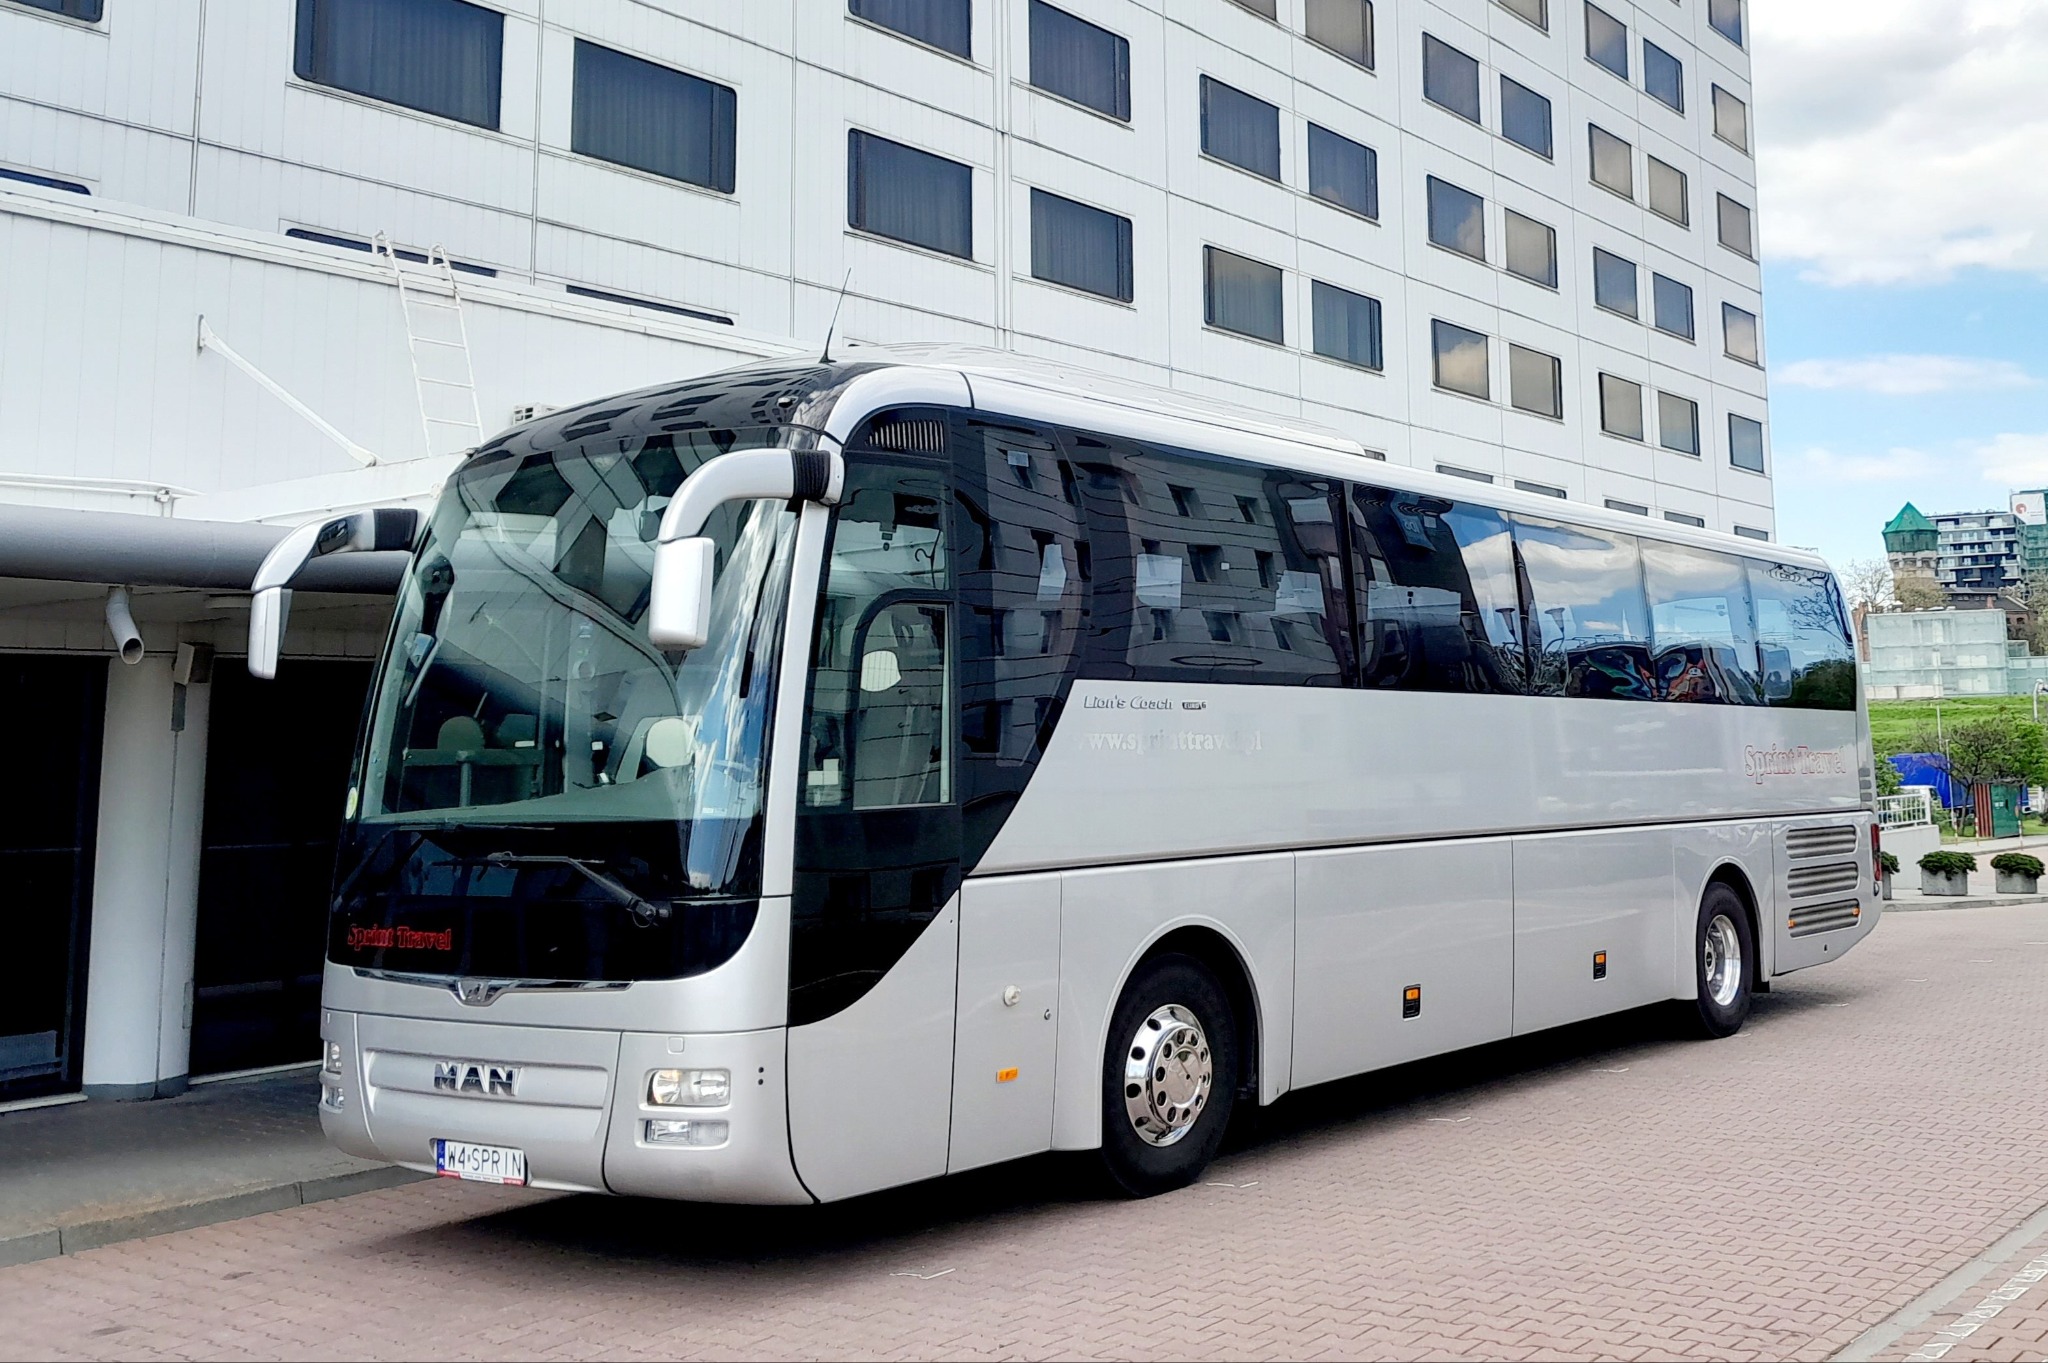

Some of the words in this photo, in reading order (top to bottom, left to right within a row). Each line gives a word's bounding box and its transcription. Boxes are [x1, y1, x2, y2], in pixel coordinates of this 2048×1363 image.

[1083, 695, 1127, 709] Lion's
[1130, 695, 1173, 710] Coach
[1744, 743, 1796, 785] Sprint
[1797, 745, 1846, 775] Travel
[348, 924, 394, 951] Sprint
[397, 926, 451, 950] Travel
[433, 1061, 524, 1097] MAN
